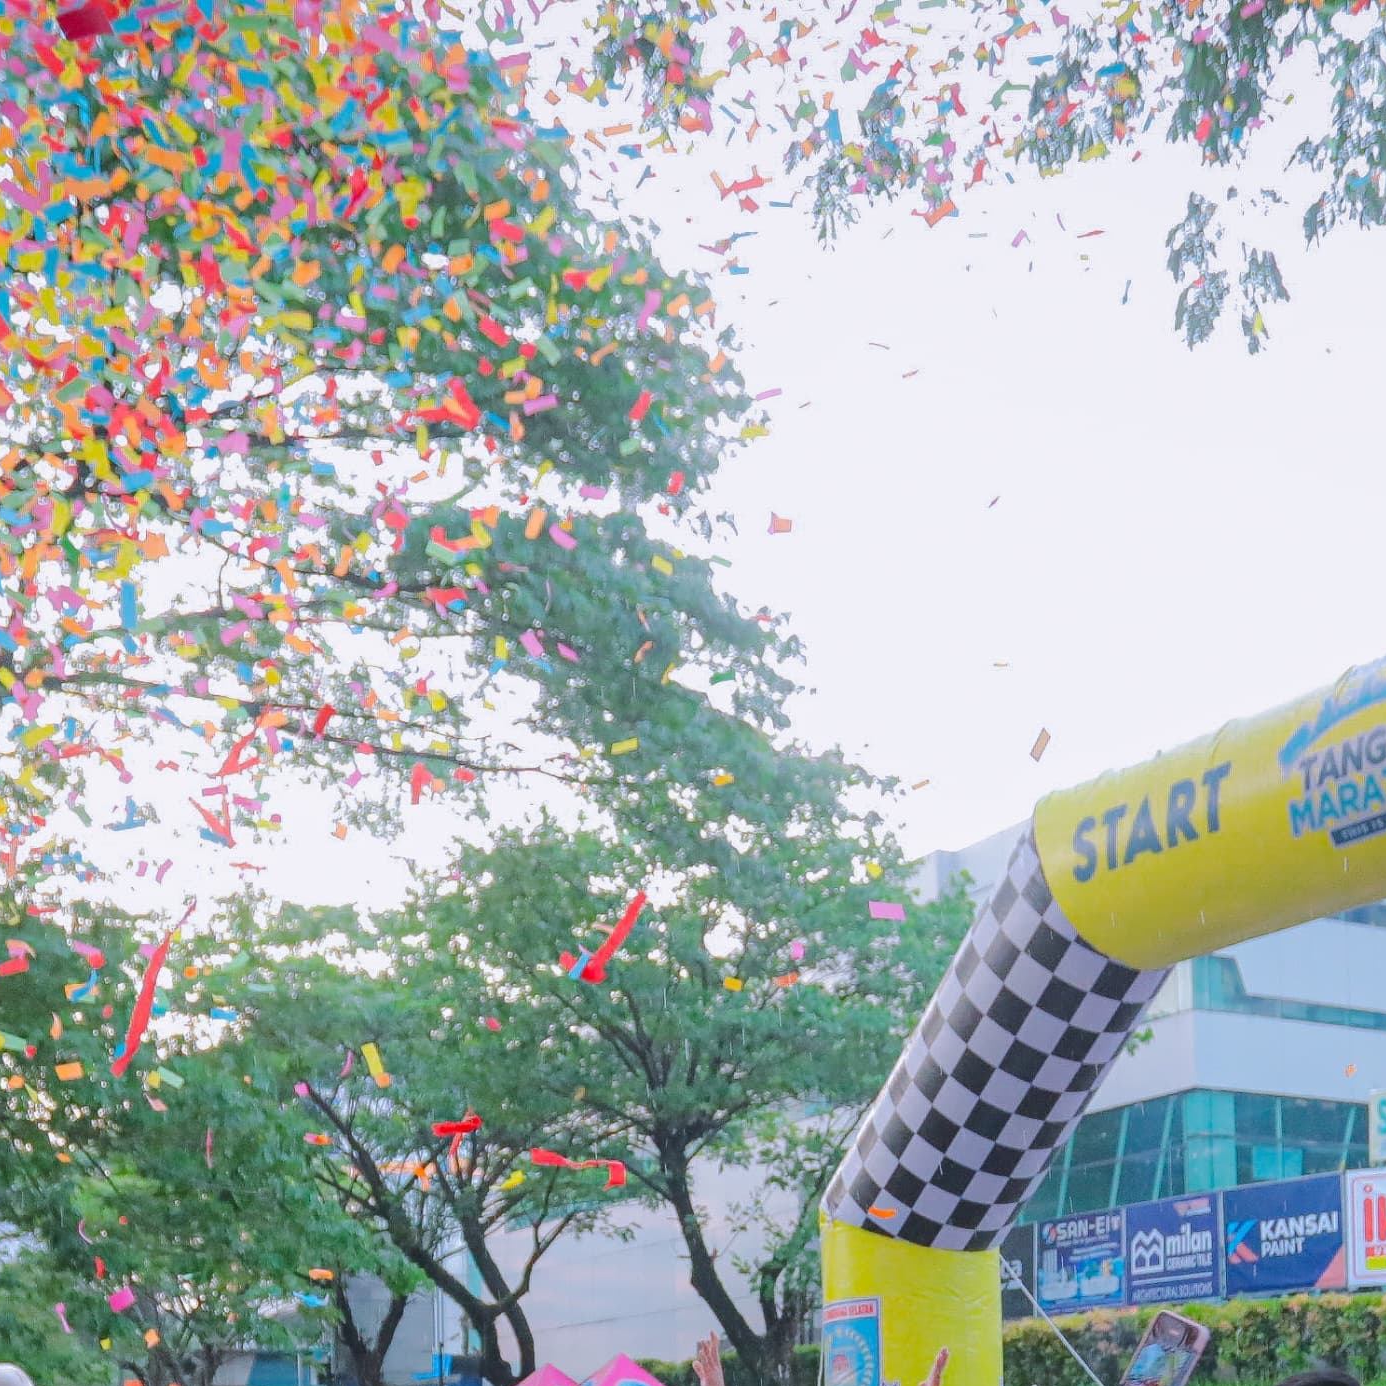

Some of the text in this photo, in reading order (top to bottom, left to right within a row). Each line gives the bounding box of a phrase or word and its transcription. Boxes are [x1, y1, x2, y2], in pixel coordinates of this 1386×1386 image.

[1072, 762, 1231, 883] START
[1165, 1222, 1213, 1256] milan
[1259, 1210, 1339, 1242] KANSAI
[1261, 1235, 1306, 1258] PAINT
